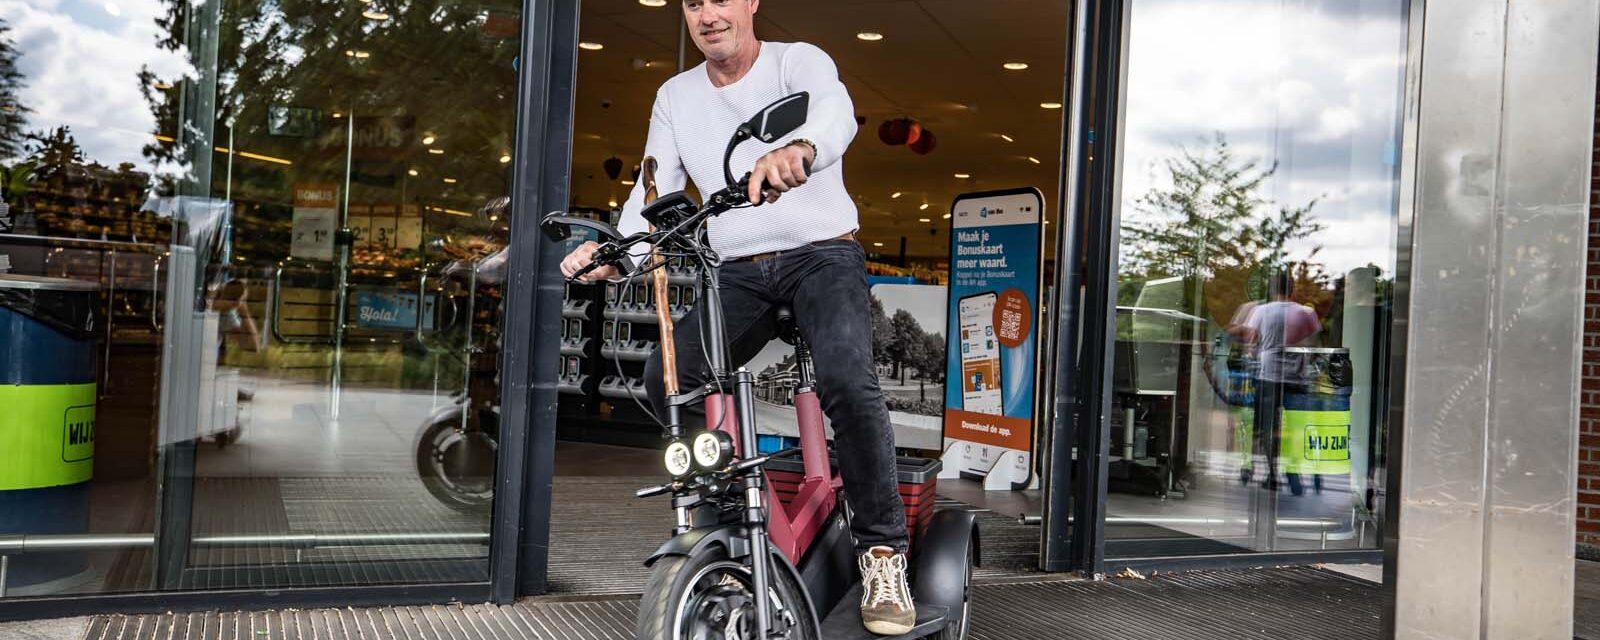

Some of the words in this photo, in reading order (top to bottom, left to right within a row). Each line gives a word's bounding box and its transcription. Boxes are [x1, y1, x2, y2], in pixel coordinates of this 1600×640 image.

[297, 190, 333, 201] BONUS
[958, 230, 980, 243] Maak
[981, 230, 990, 245] je
[957, 244, 1004, 256] Bonuskaart
[957, 259, 977, 268] meer
[979, 256, 1008, 268] waard.
[360, 306, 400, 321] Hola!
[69, 421, 89, 445] WIJ
[961, 420, 989, 433] Download
[990, 424, 998, 434] de
[998, 427, 1012, 437] app.
[1309, 435, 1329, 450] WIJ
